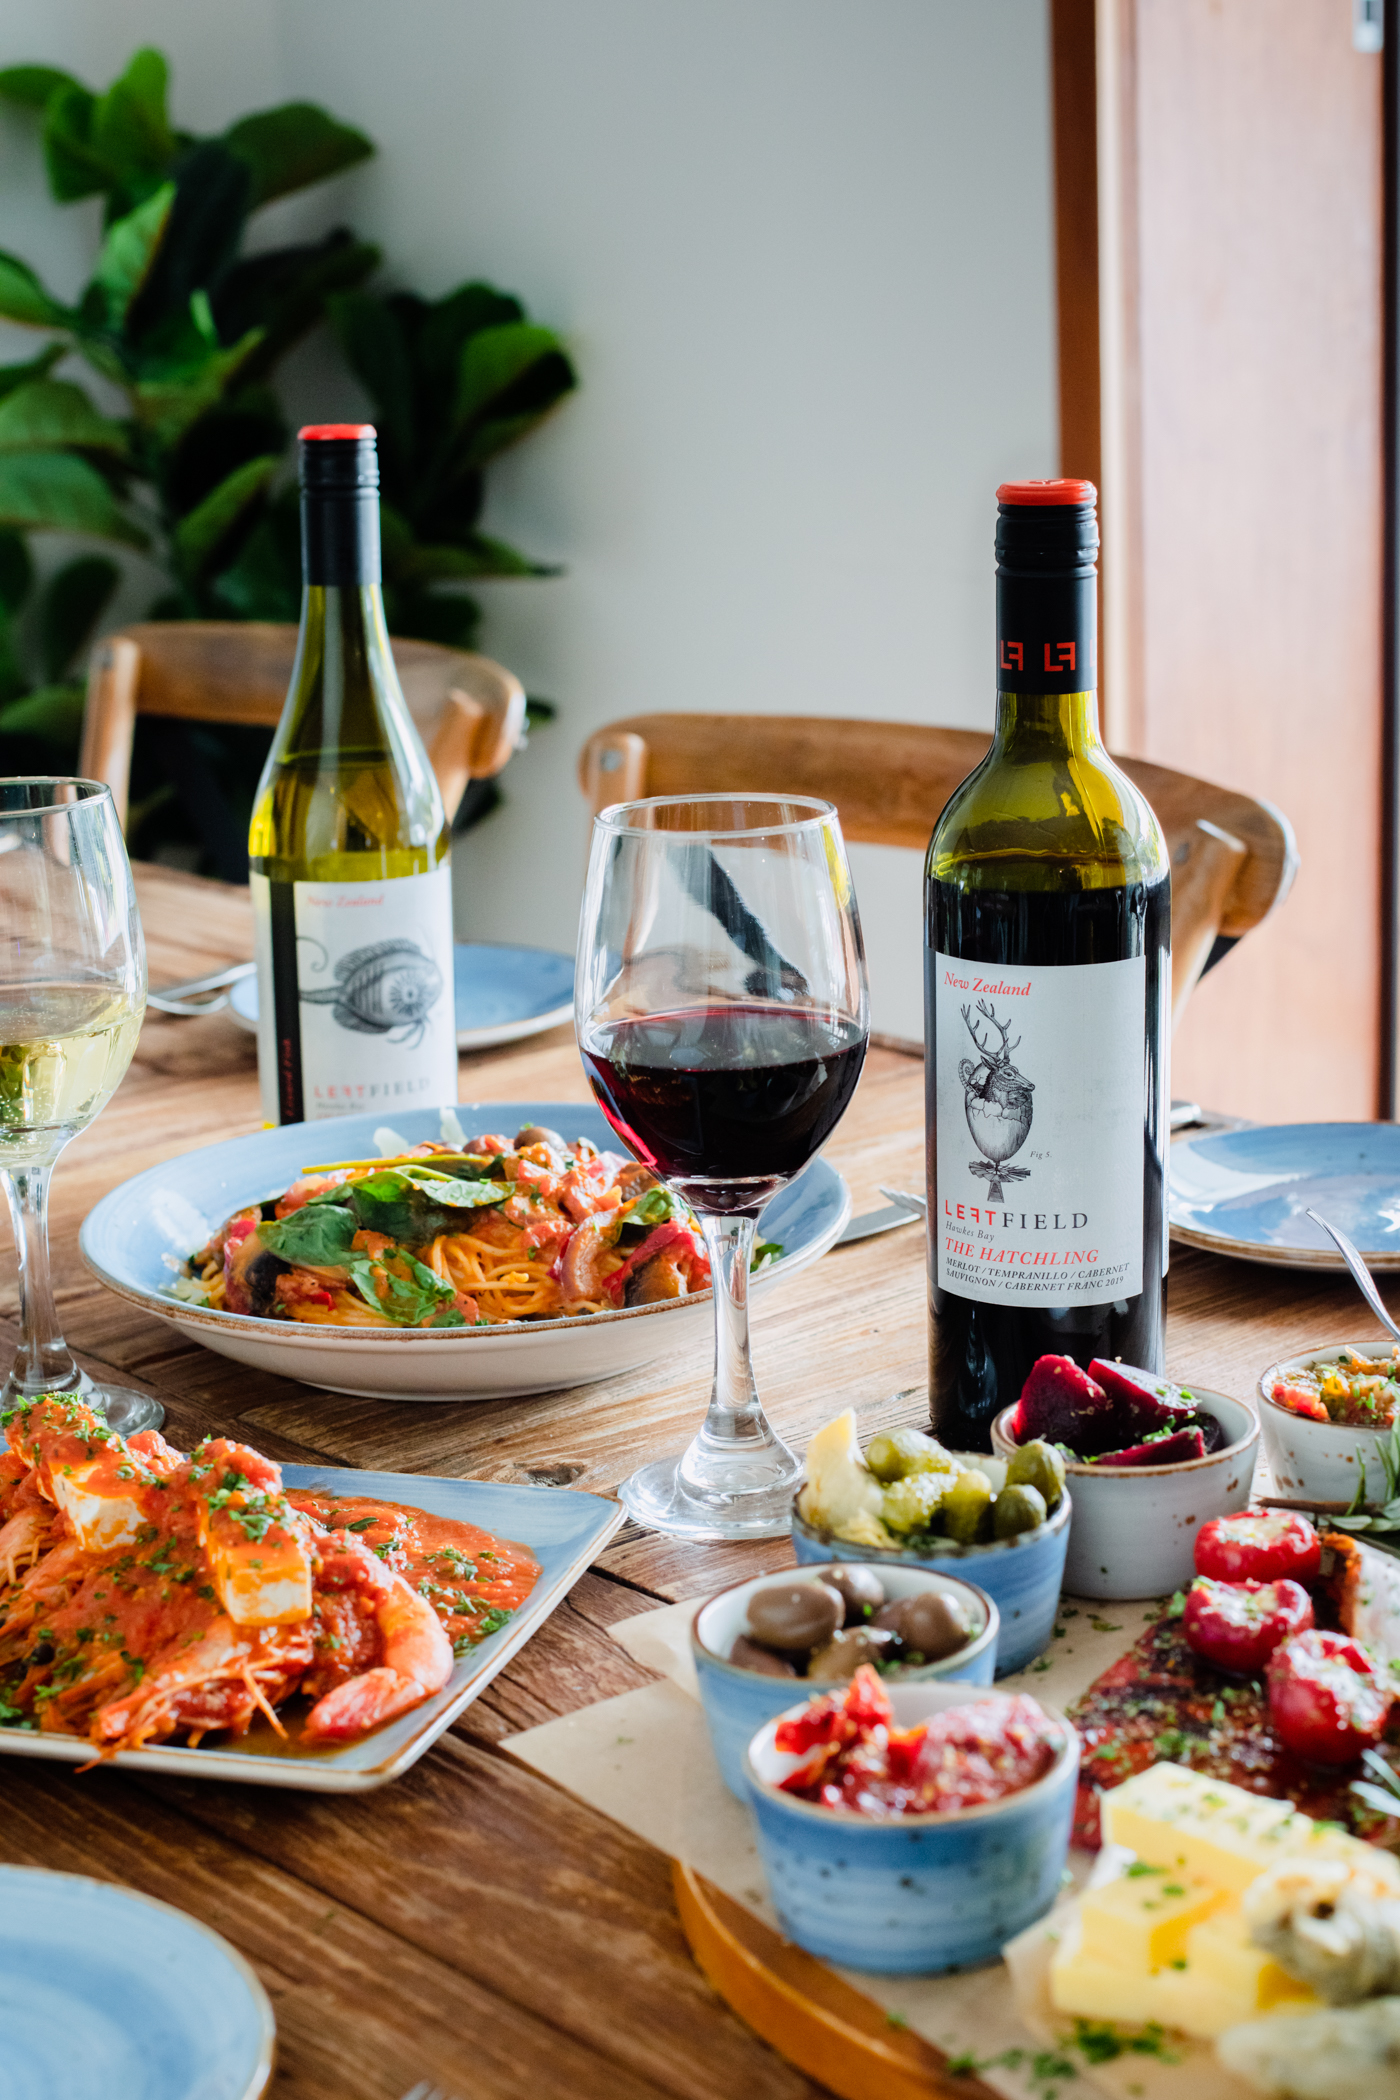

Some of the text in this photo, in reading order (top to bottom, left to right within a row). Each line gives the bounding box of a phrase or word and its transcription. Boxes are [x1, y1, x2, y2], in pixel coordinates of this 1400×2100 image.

[944, 971, 1032, 996] New Zealand
[1029, 1150, 1043, 1160] Fig
[945, 1220, 995, 1243] Hawkes Bay
[945, 1236, 1099, 1266] THE HATCHLING
[946, 1256, 981, 1274] MERLOT
[987, 1267, 1068, 1280] TEMPRANILLO
[1078, 1262, 1130, 1279] CABERNET
[946, 1267, 997, 1288] SAUVIGNON
[1005, 1281, 1065, 1291] CABERNET
[1067, 1280, 1104, 1291] FRANC
[1105, 1275, 1124, 1287] 2019
